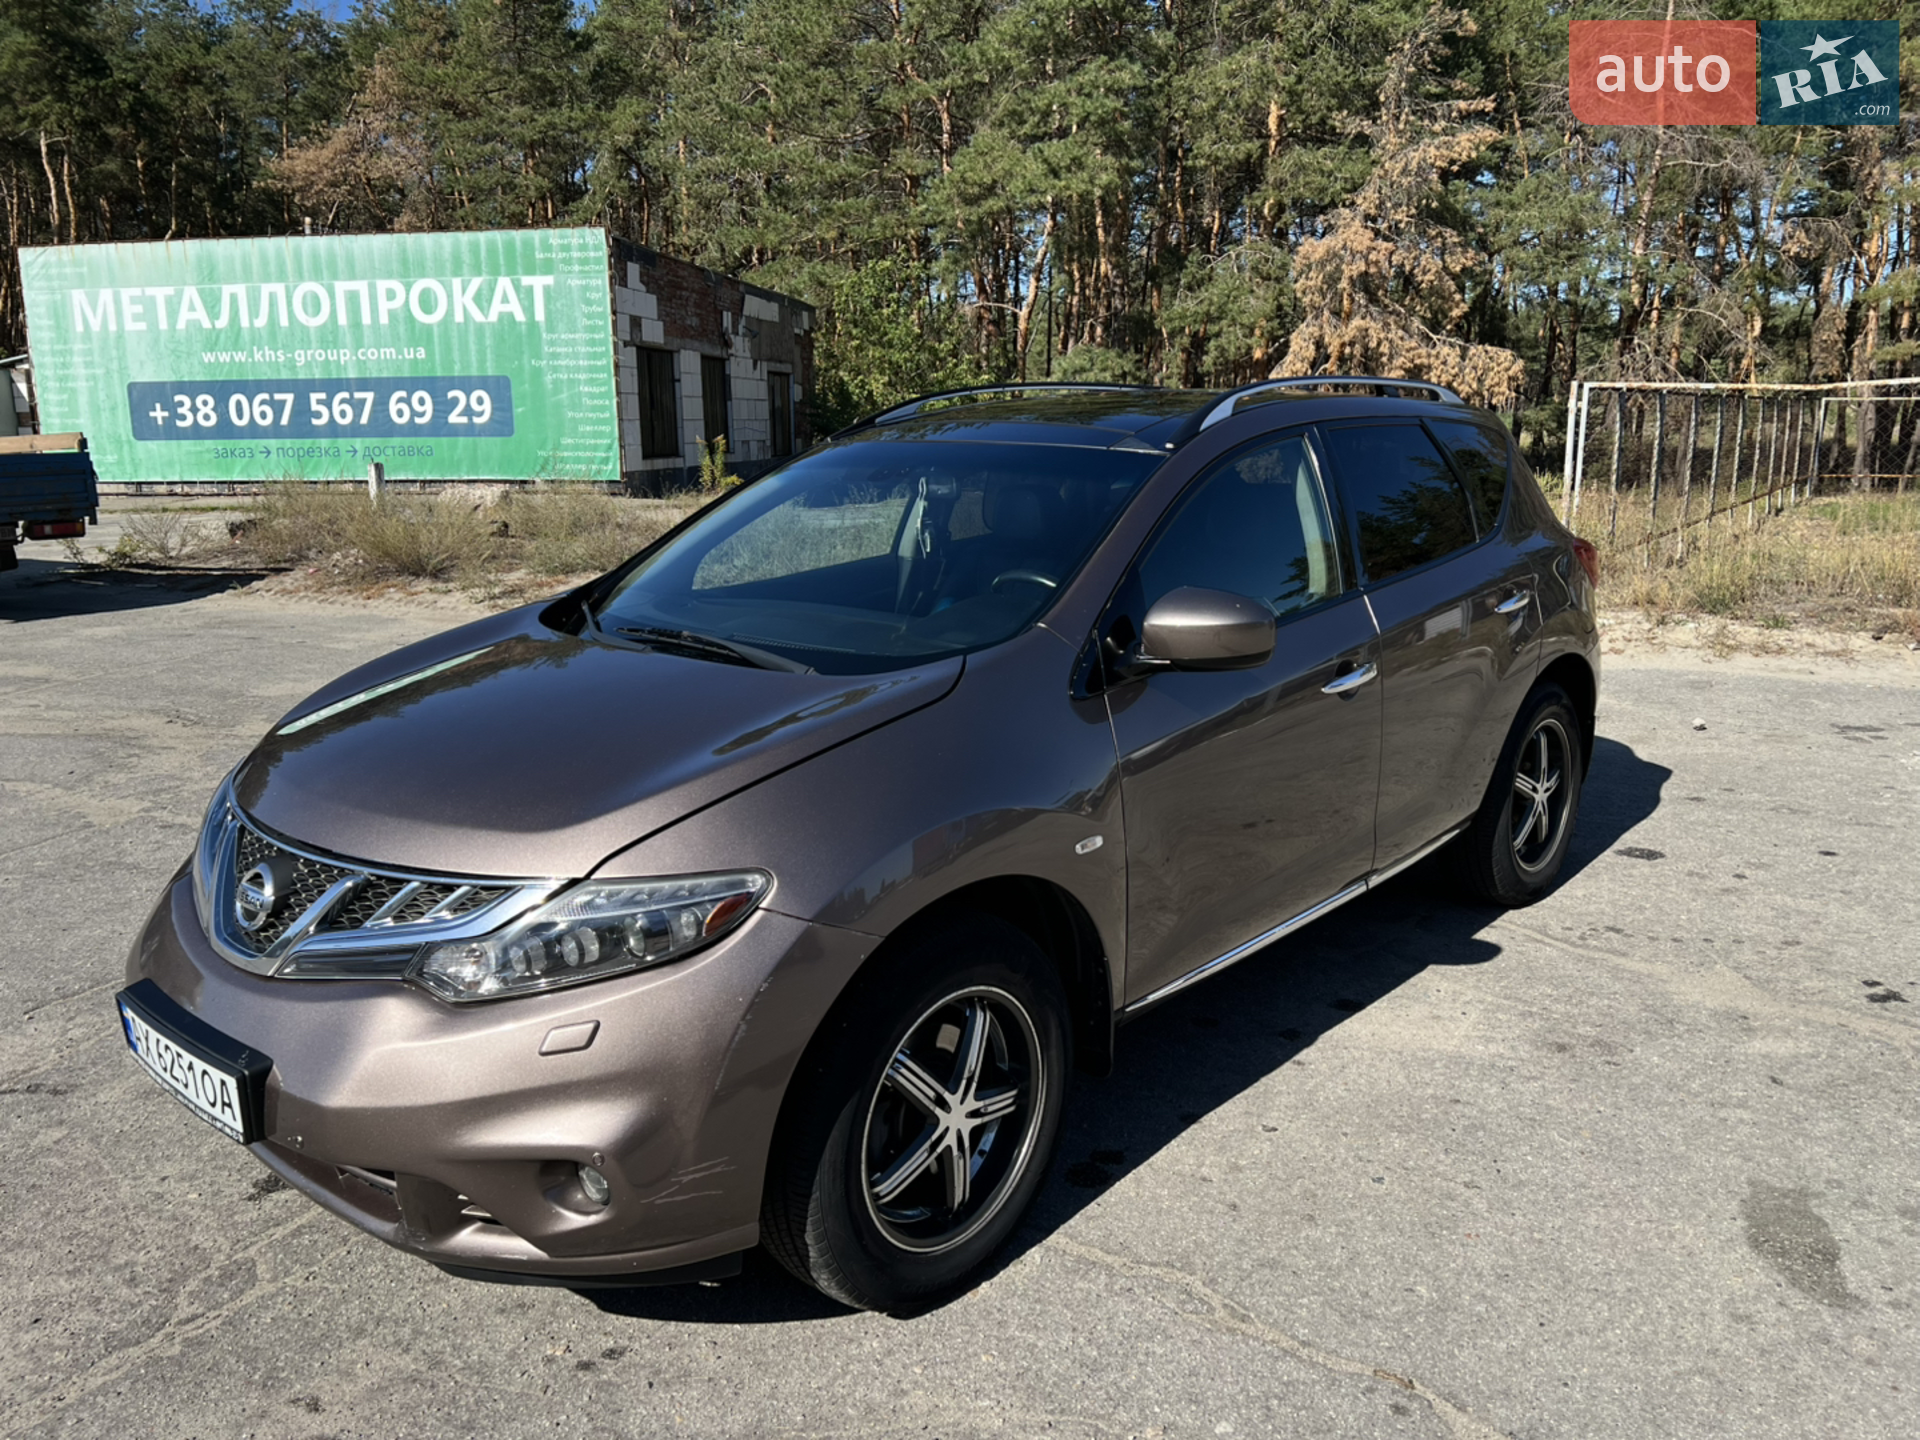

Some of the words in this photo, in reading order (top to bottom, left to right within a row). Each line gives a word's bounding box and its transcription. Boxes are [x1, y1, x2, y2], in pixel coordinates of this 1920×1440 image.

[559, 264, 604, 272] Профнастил
[566, 278, 602, 287] Арматура
[586, 291, 602, 300] Круг
[72, 275, 554, 332] МЕТАЛЛОПРОКАТ
[580, 304, 604, 313] Трубы
[582, 318, 604, 326] Листы
[202, 346, 426, 366] www.khs-group.com.ua
[531, 358, 547, 367] Круг
[580, 385, 609, 393] Квадрат
[582, 397, 610, 405] Полоса
[149, 395, 218, 427] +38
[228, 392, 295, 427] 067
[309, 391, 375, 426] 567
[388, 390, 434, 425] 69
[447, 389, 492, 424] 29
[578, 424, 612, 432] Швеллер
[213, 446, 255, 459] заказ
[276, 445, 341, 461] порезка
[362, 443, 434, 460] доставка
